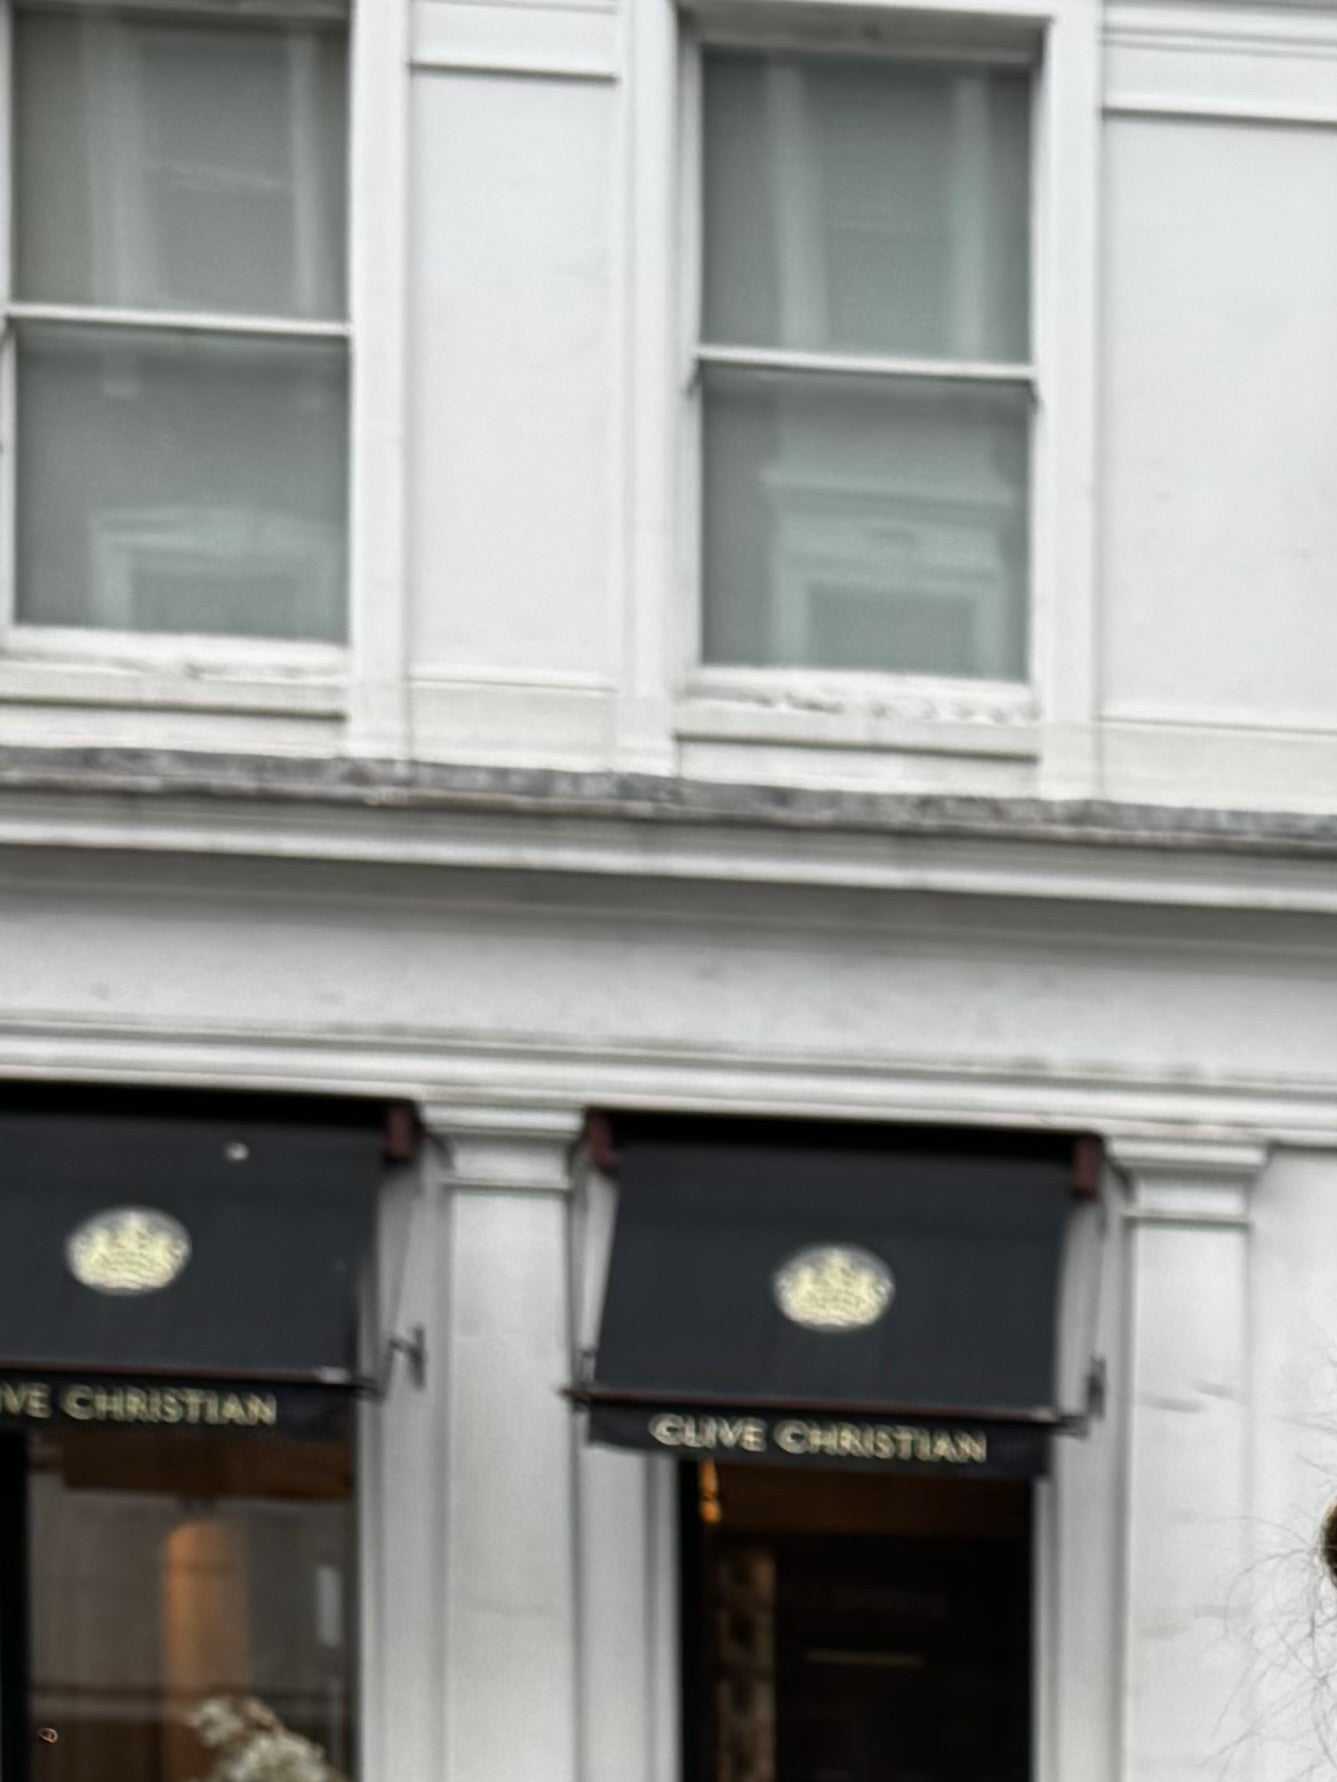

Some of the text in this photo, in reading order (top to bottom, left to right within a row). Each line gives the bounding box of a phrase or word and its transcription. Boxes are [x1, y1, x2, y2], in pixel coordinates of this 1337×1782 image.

[0, 1381, 277, 1426] VE CHRISTIAN
[649, 1413, 987, 1464] CLIVE CHRISTIAN
